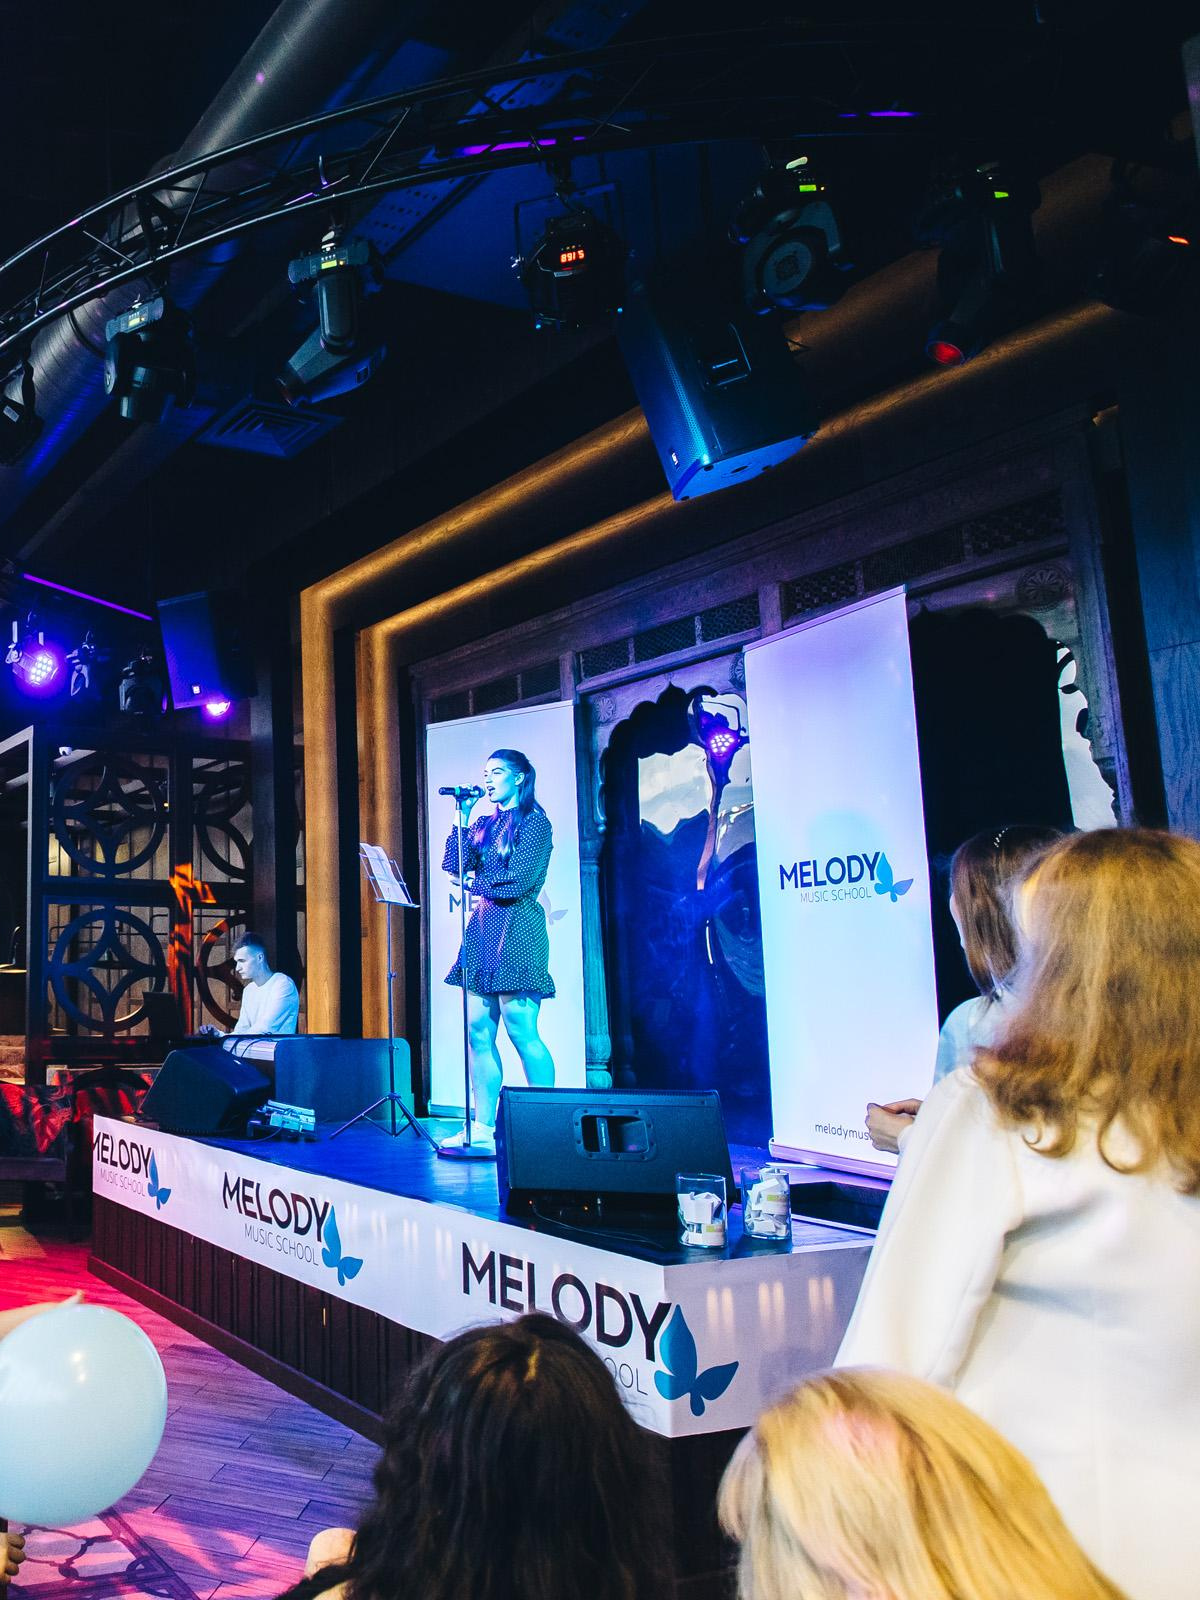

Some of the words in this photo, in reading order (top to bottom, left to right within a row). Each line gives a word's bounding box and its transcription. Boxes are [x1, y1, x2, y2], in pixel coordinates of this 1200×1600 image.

[779, 852, 880, 890] MELODY
[800, 889, 829, 903] MUSIC
[831, 886, 872, 901] SCHOOL
[814, 1122, 871, 1141] melodymus
[98, 1165, 119, 1187] MUSIC
[119, 1175, 146, 1198] SCHOOL
[222, 1171, 330, 1243] MELODY
[244, 1223, 274, 1249] MUSIC
[275, 1234, 319, 1267] SCHOOL
